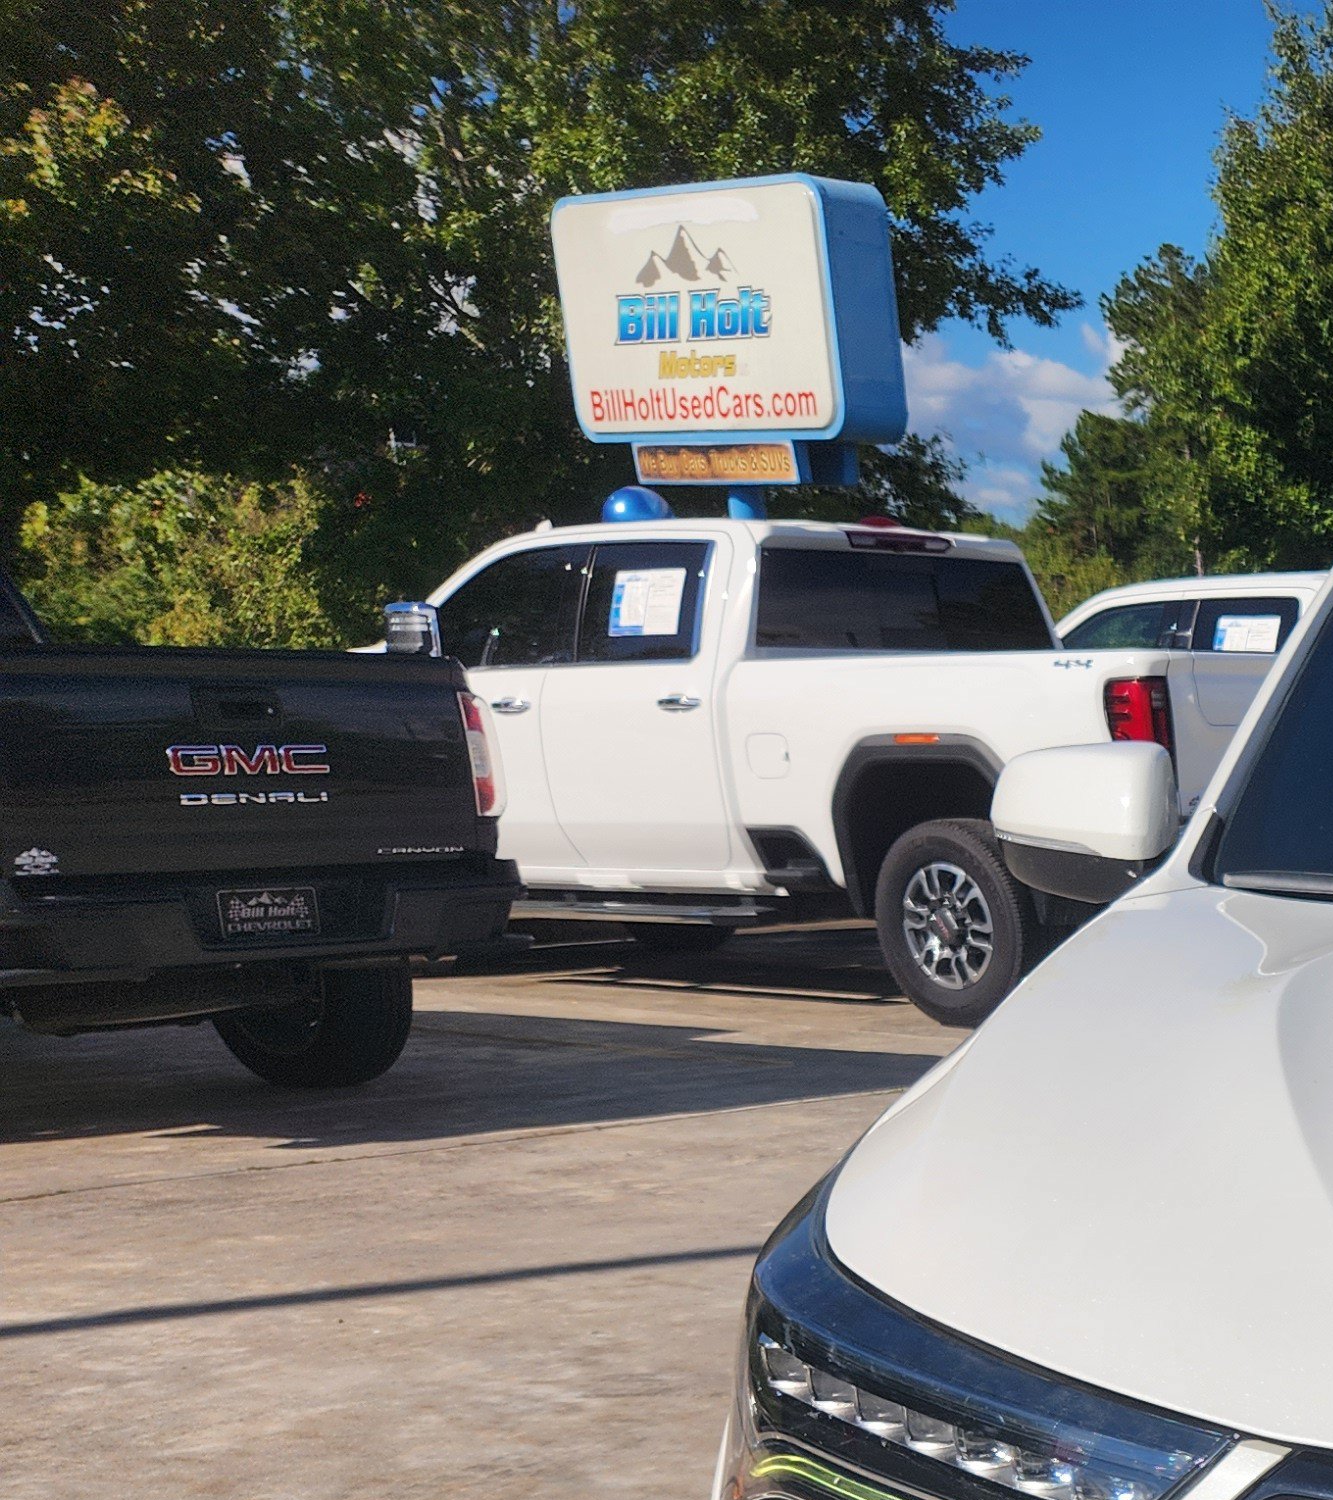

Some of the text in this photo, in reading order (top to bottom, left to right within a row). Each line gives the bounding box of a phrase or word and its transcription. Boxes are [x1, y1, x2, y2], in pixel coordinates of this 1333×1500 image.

[615, 286, 772, 345] Bill Holt
[659, 351, 736, 379] Motors
[590, 386, 818, 422] BillHoltUsedCars.com
[750, 450, 759, 471] &
[760, 450, 791, 472] SUVs
[166, 745, 330, 776] GMC
[180, 791, 328, 806] DENALI
